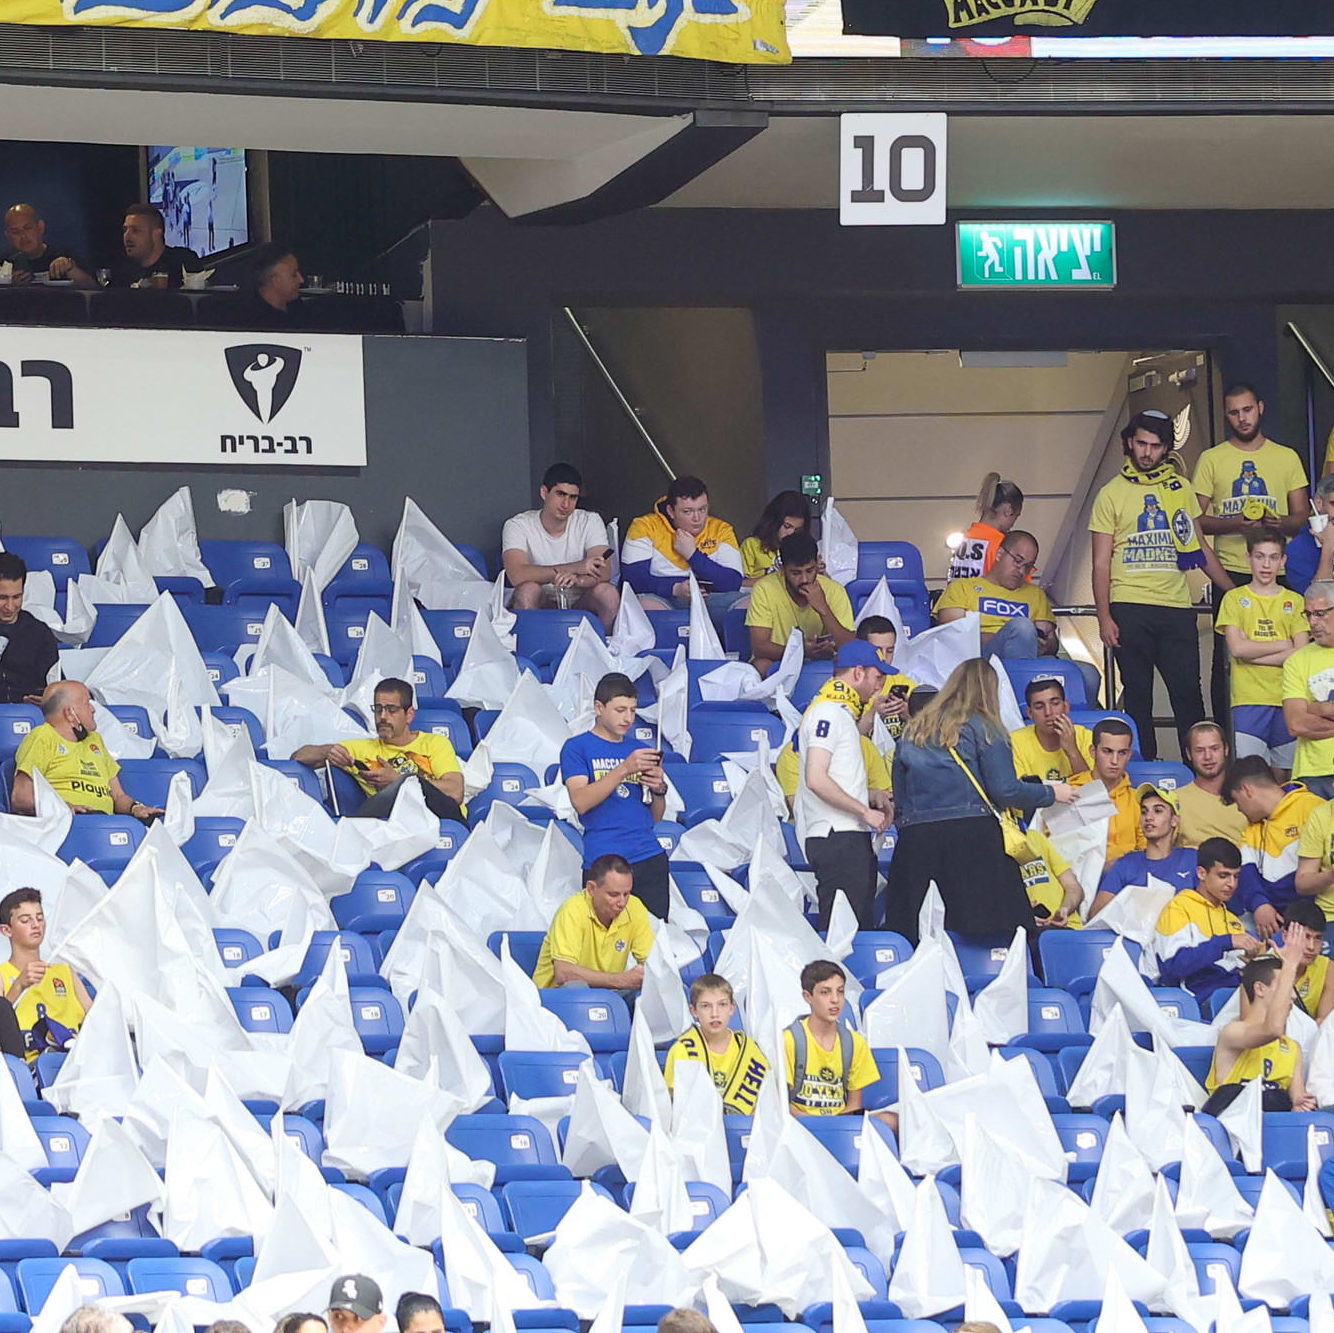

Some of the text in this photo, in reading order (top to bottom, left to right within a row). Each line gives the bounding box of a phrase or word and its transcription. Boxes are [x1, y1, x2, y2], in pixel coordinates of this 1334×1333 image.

[851, 134, 936, 203] 10
[1013, 228, 1101, 280] יציאה
[221, 434, 313, 454] רב-בריח
[1124, 546, 1179, 564] MADNES
[984, 600, 1026, 617] FOX
[815, 720, 831, 738] 8
[70, 779, 111, 798] Playti
[1020, 858, 1044, 880] ARS
[733, 1059, 763, 1108] HELL
